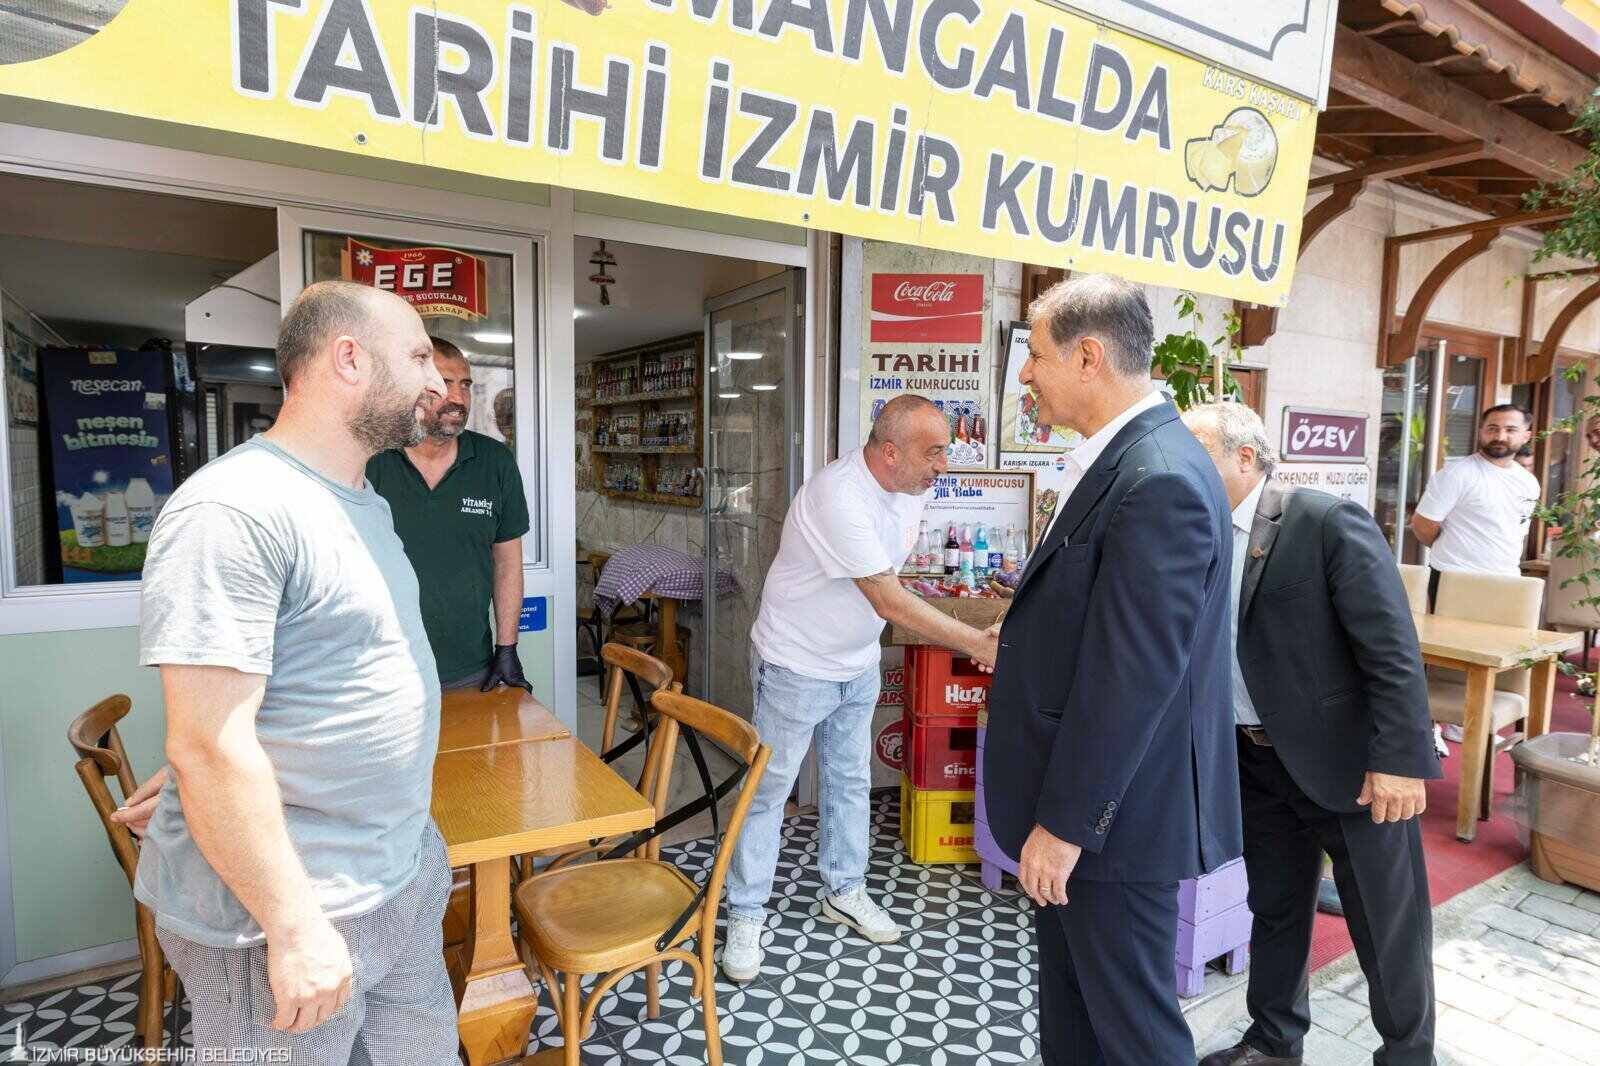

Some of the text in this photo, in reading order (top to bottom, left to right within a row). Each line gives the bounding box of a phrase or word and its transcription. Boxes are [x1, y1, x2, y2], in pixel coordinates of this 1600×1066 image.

[655, 0, 1171, 150] ANGALDA
[1203, 66, 1246, 100] KARS
[236, 0, 1285, 283] TARİHİ İZMİR KUMRUSU
[374, 262, 454, 290] EGE
[416, 292, 468, 303] SUCUKLARI
[431, 305, 464, 315] KASAP
[872, 348, 981, 373] TARİHİ
[870, 374, 981, 391] İZMİR KUMRUCUSU
[63, 430, 160, 450] bitmesin
[1291, 418, 1357, 453] ÖZEV
[932, 476, 1025, 489] ZMİR KUMRUCUSU
[934, 486, 983, 500] Ali Baba
